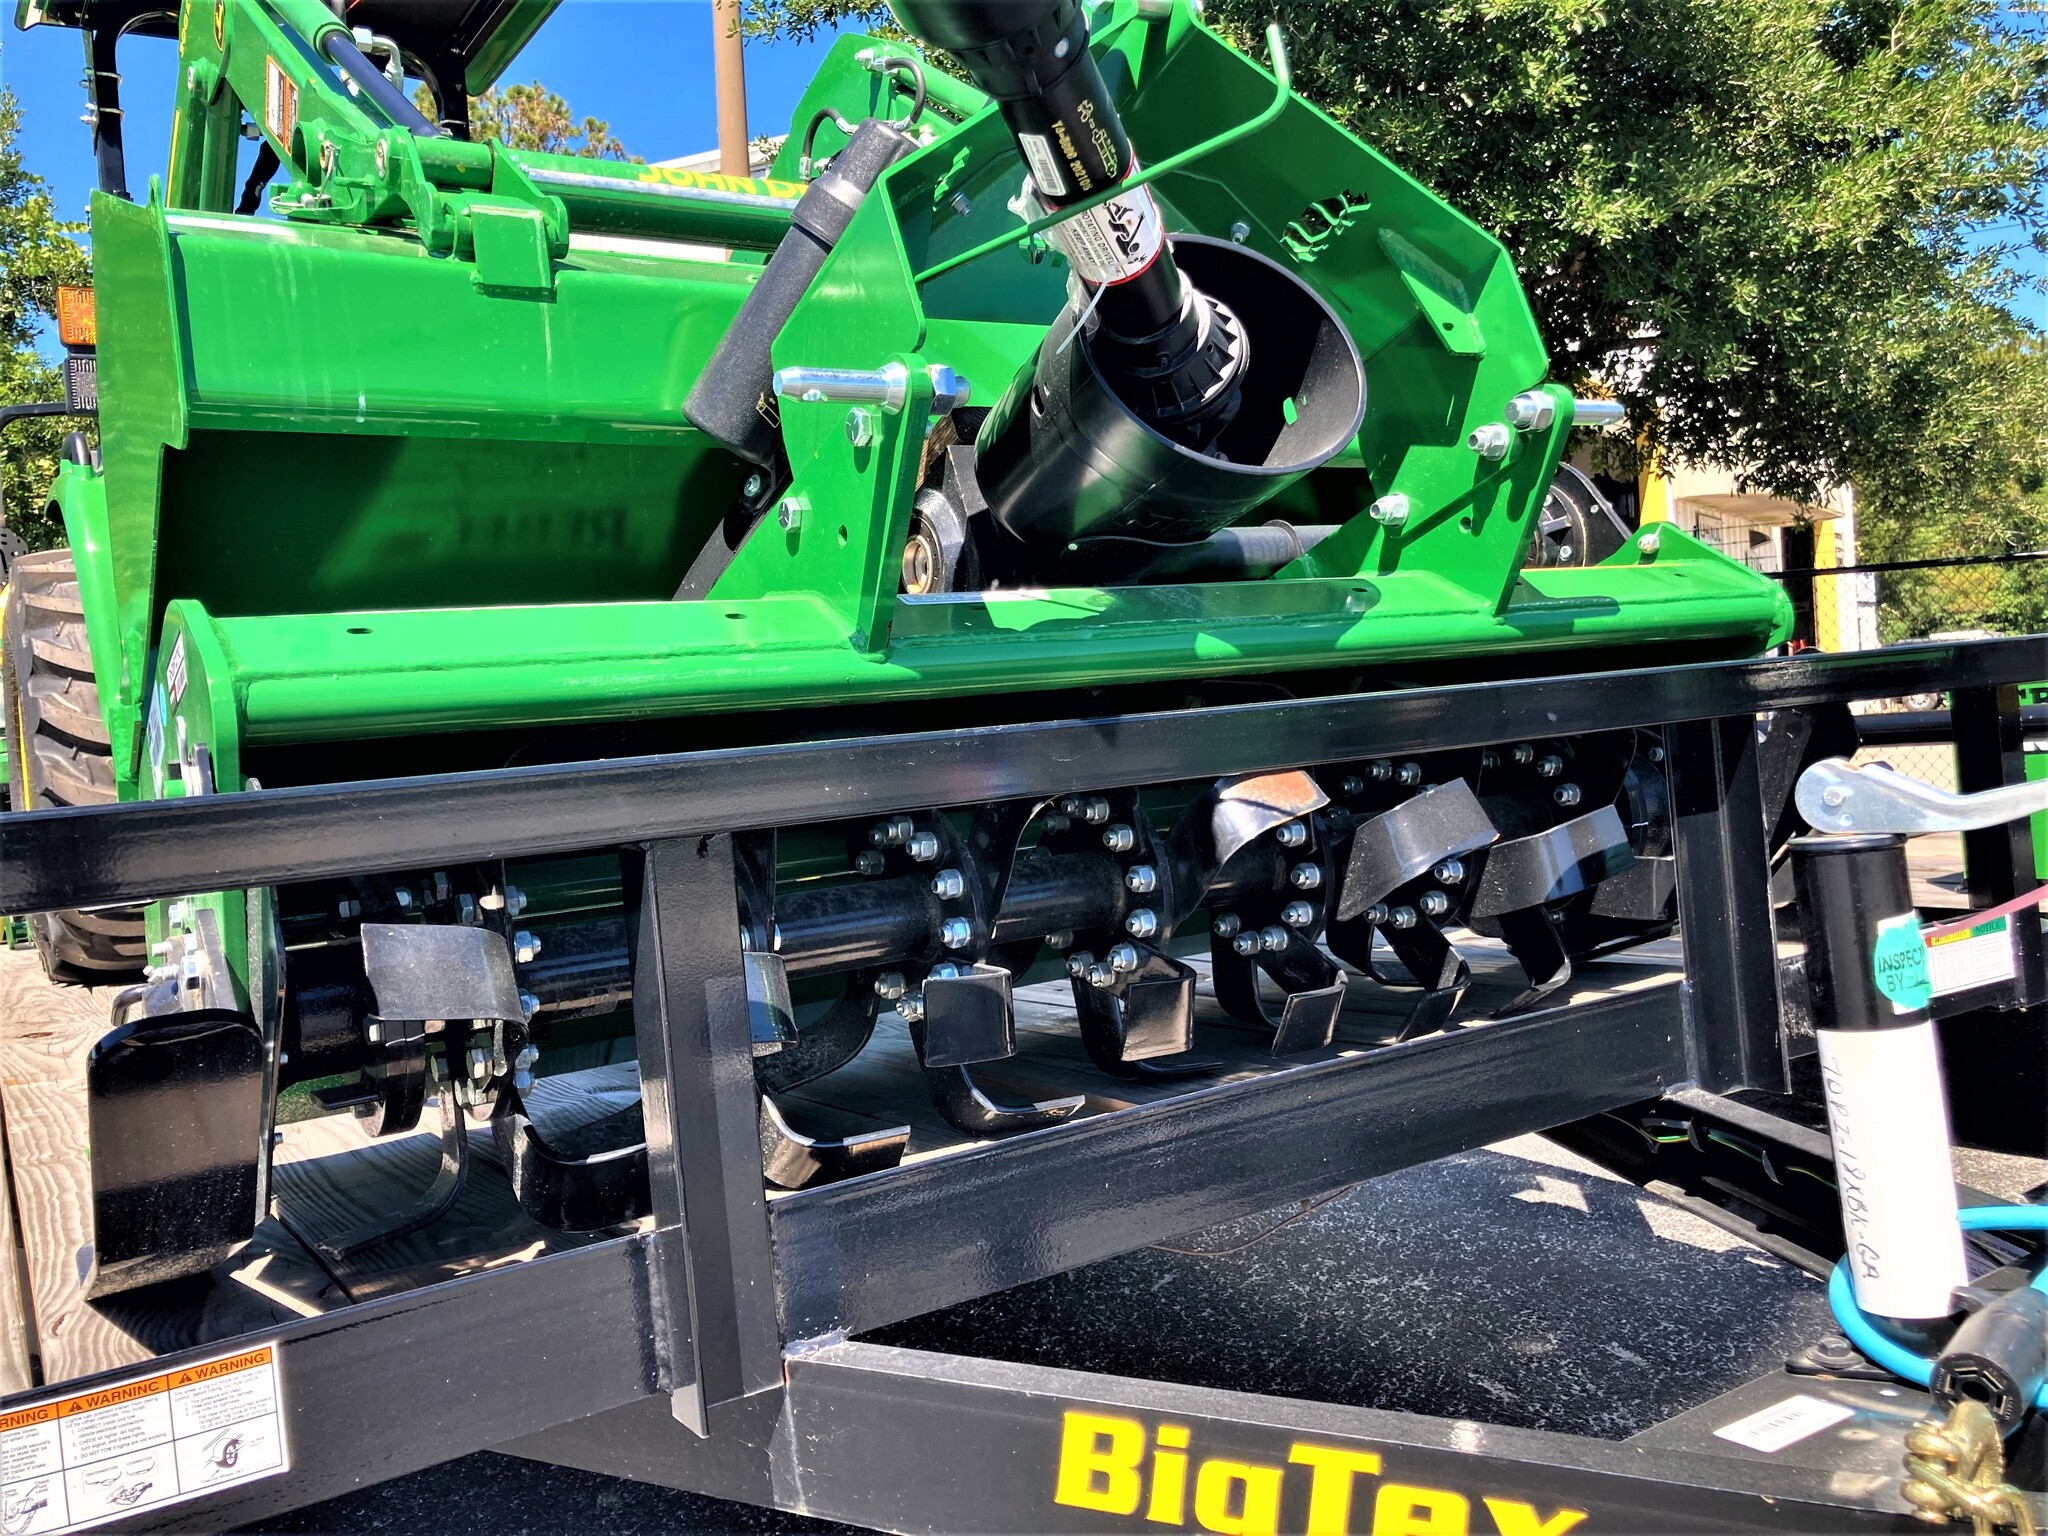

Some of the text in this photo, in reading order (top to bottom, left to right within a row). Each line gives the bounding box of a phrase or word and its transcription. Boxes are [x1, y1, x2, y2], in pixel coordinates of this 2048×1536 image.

[638, 165, 757, 195] JOHN
[1975, 920, 2000, 934] NOTICE
[1886, 972, 1906, 993] BY
[195, 1353, 264, 1379] WARNING
[86, 1381, 159, 1408] WARNING
